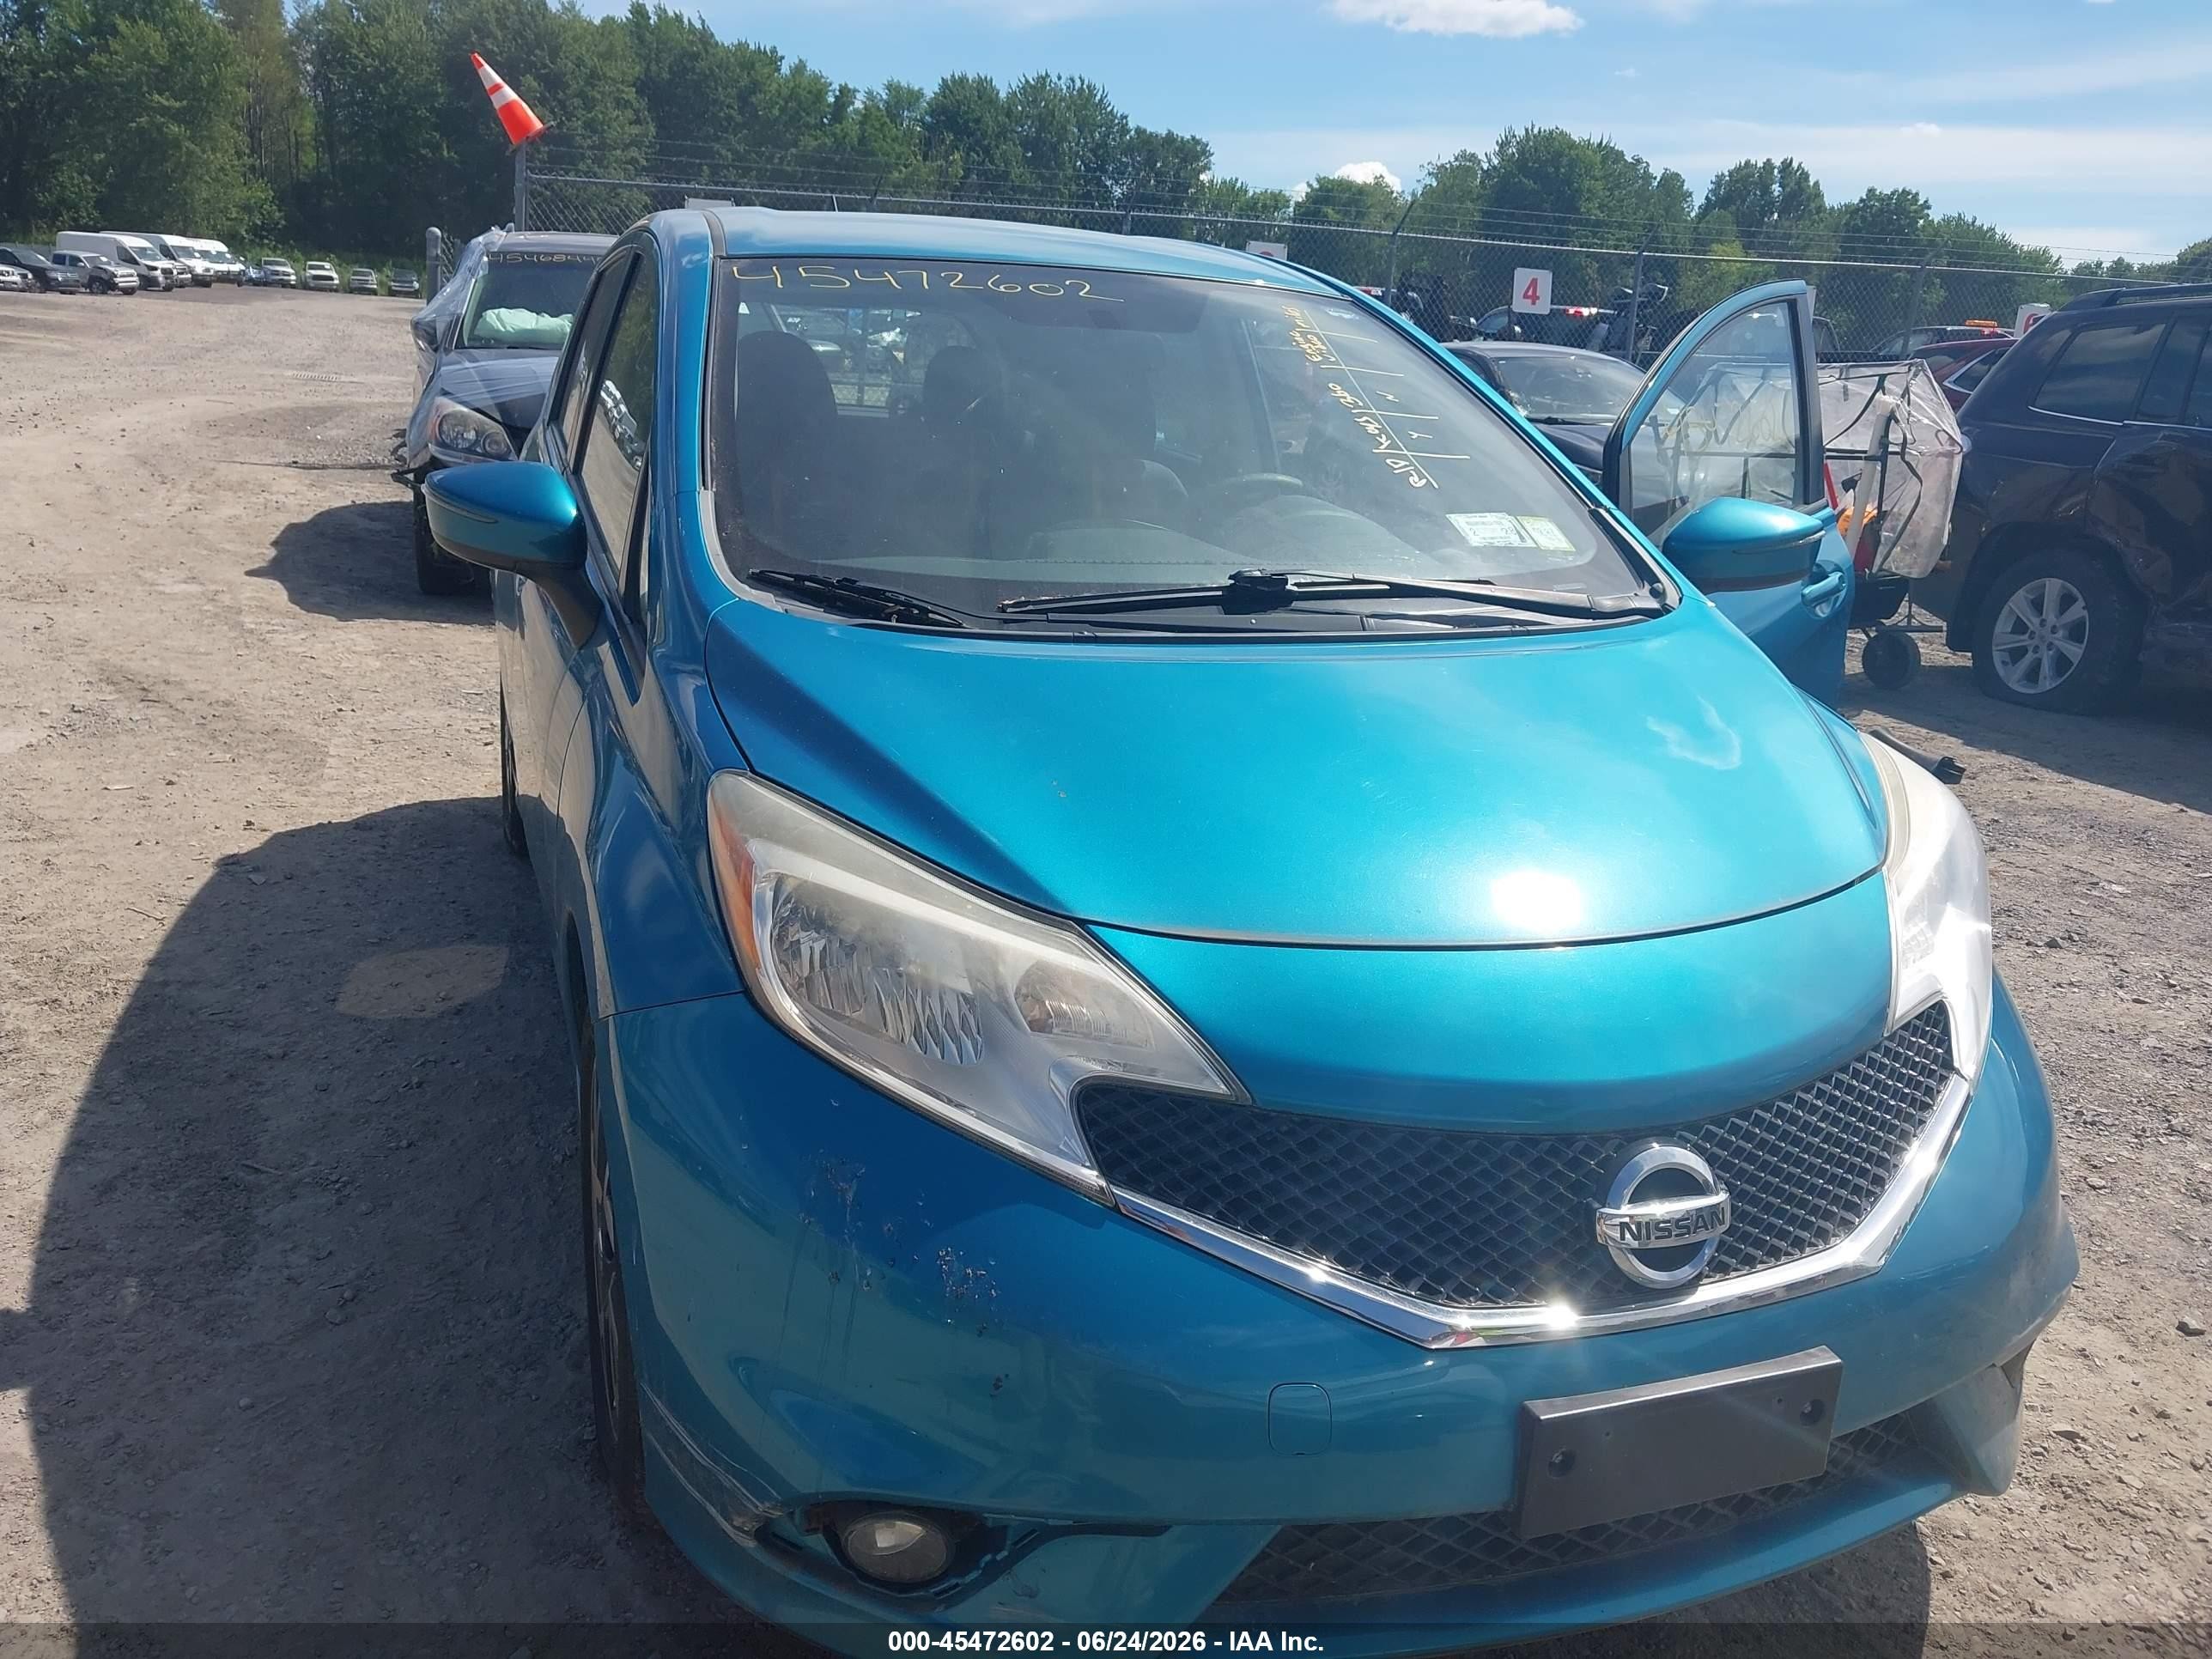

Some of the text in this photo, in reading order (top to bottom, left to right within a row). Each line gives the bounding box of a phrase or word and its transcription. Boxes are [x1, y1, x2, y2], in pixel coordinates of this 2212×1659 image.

[489, 252, 603, 264] 4546844
[732, 265, 1125, 302] 45472602
[1522, 277, 1540, 306] 4
[1328, 382, 1364, 408] 360
[1620, 1206, 1725, 1242] NISSAN
